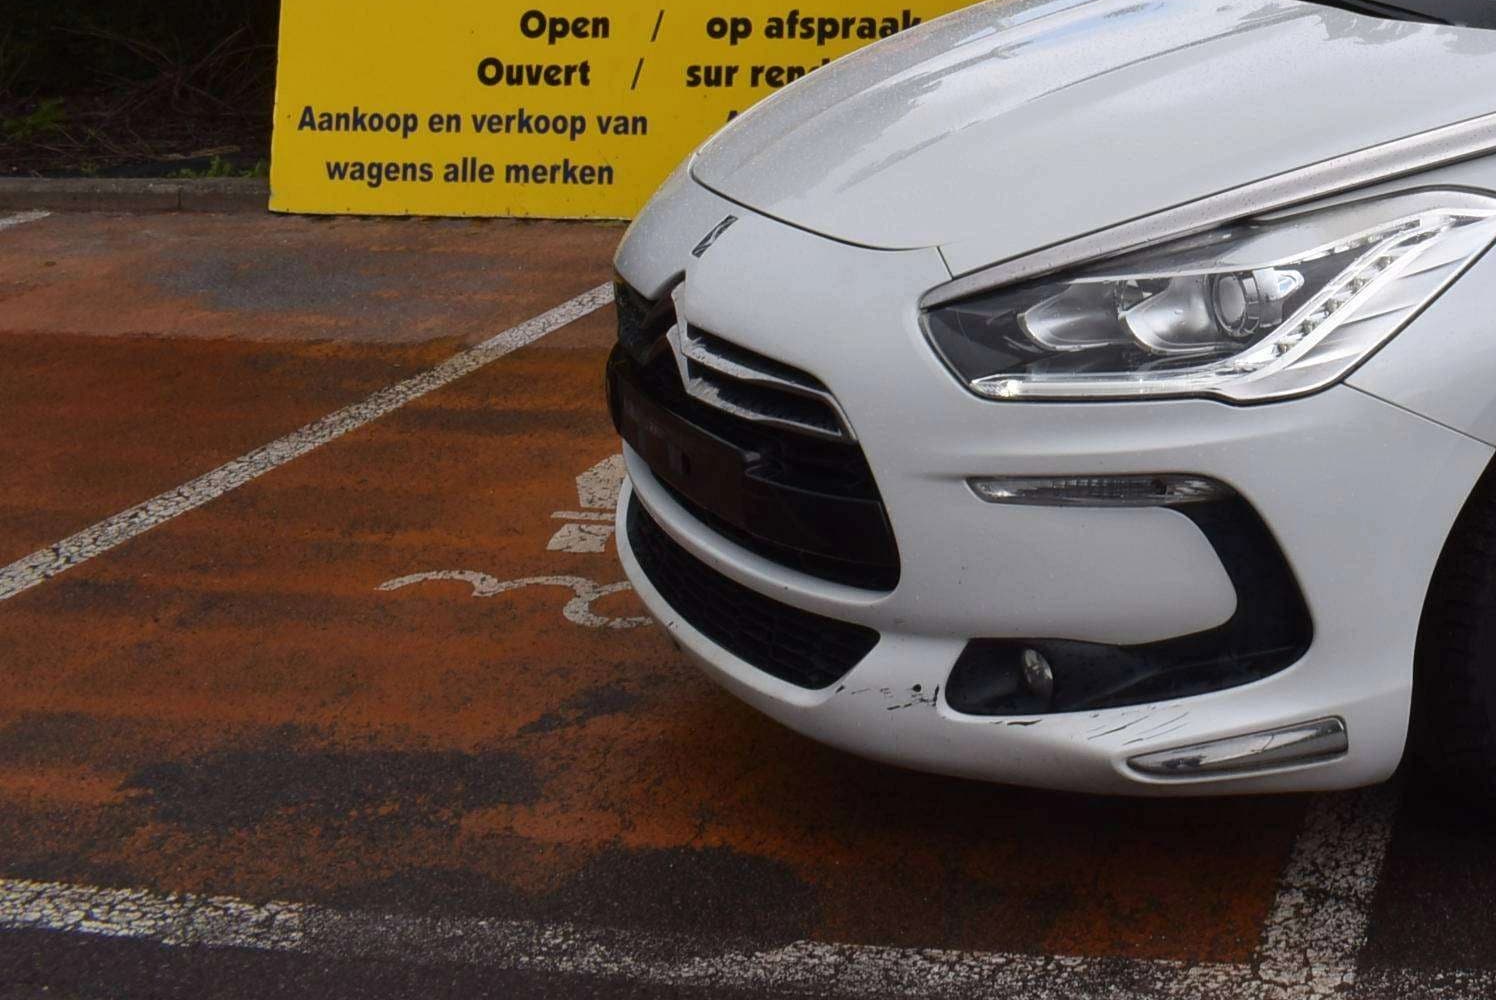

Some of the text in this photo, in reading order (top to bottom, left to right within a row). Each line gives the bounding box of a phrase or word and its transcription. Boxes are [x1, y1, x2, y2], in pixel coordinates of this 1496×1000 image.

[519, 9, 610, 46] Open
[705, 16, 753, 47] op
[476, 56, 591, 87] Ouvert
[685, 64, 740, 88] sur
[750, 57, 831, 89] ren
[297, 105, 648, 142] Aankoop en verkoop van
[325, 156, 615, 189] wagens alle merken
